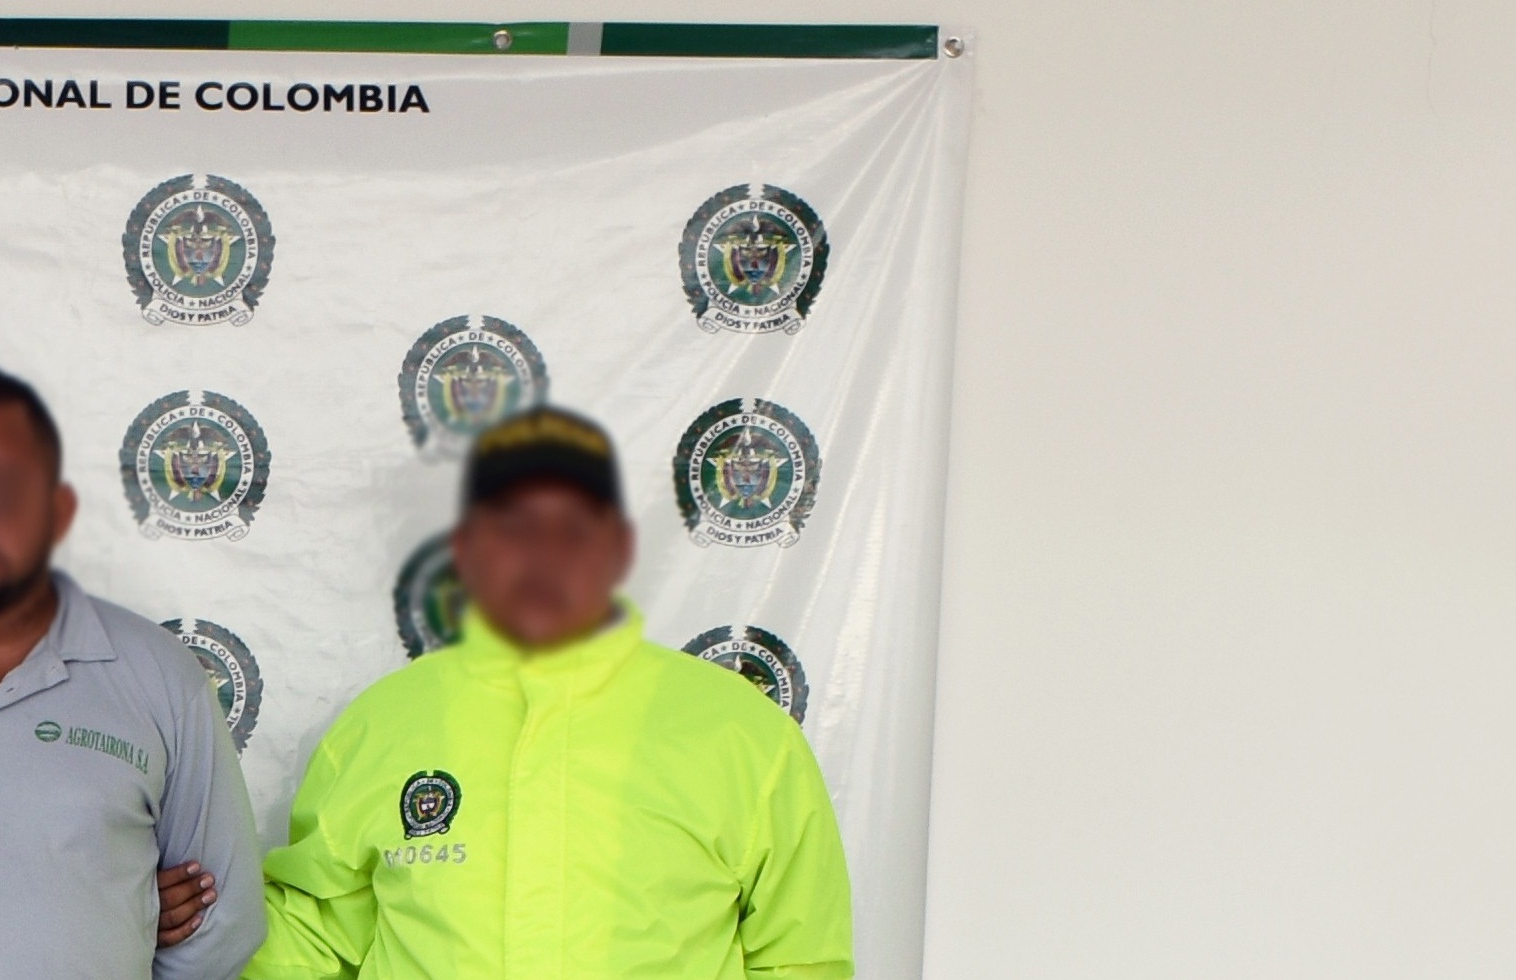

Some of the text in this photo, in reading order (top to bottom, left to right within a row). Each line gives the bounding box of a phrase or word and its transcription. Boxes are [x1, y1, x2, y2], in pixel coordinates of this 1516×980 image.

[125, 80, 181, 109] DE
[195, 82, 430, 114] COLOMBIA
[750, 201, 765, 210] DE
[194, 192, 208, 200] DE
[222, 199, 255, 259] COLOMBIA
[199, 274, 251, 307] NACIONAL
[198, 306, 237, 322] PATRIA
[469, 332, 484, 341] DE
[190, 408, 205, 416] DE
[218, 415, 251, 475] COLOMBIA
[741, 416, 757, 424] DE
[769, 423, 802, 482] COLOMBIA
[195, 489, 247, 522] NACIONAL
[746, 495, 797, 529] NACIONAL
[194, 520, 233, 536] PATRIA
[745, 528, 784, 543] PATRIA
[182, 636, 244, 702] DE COLOMBIA
